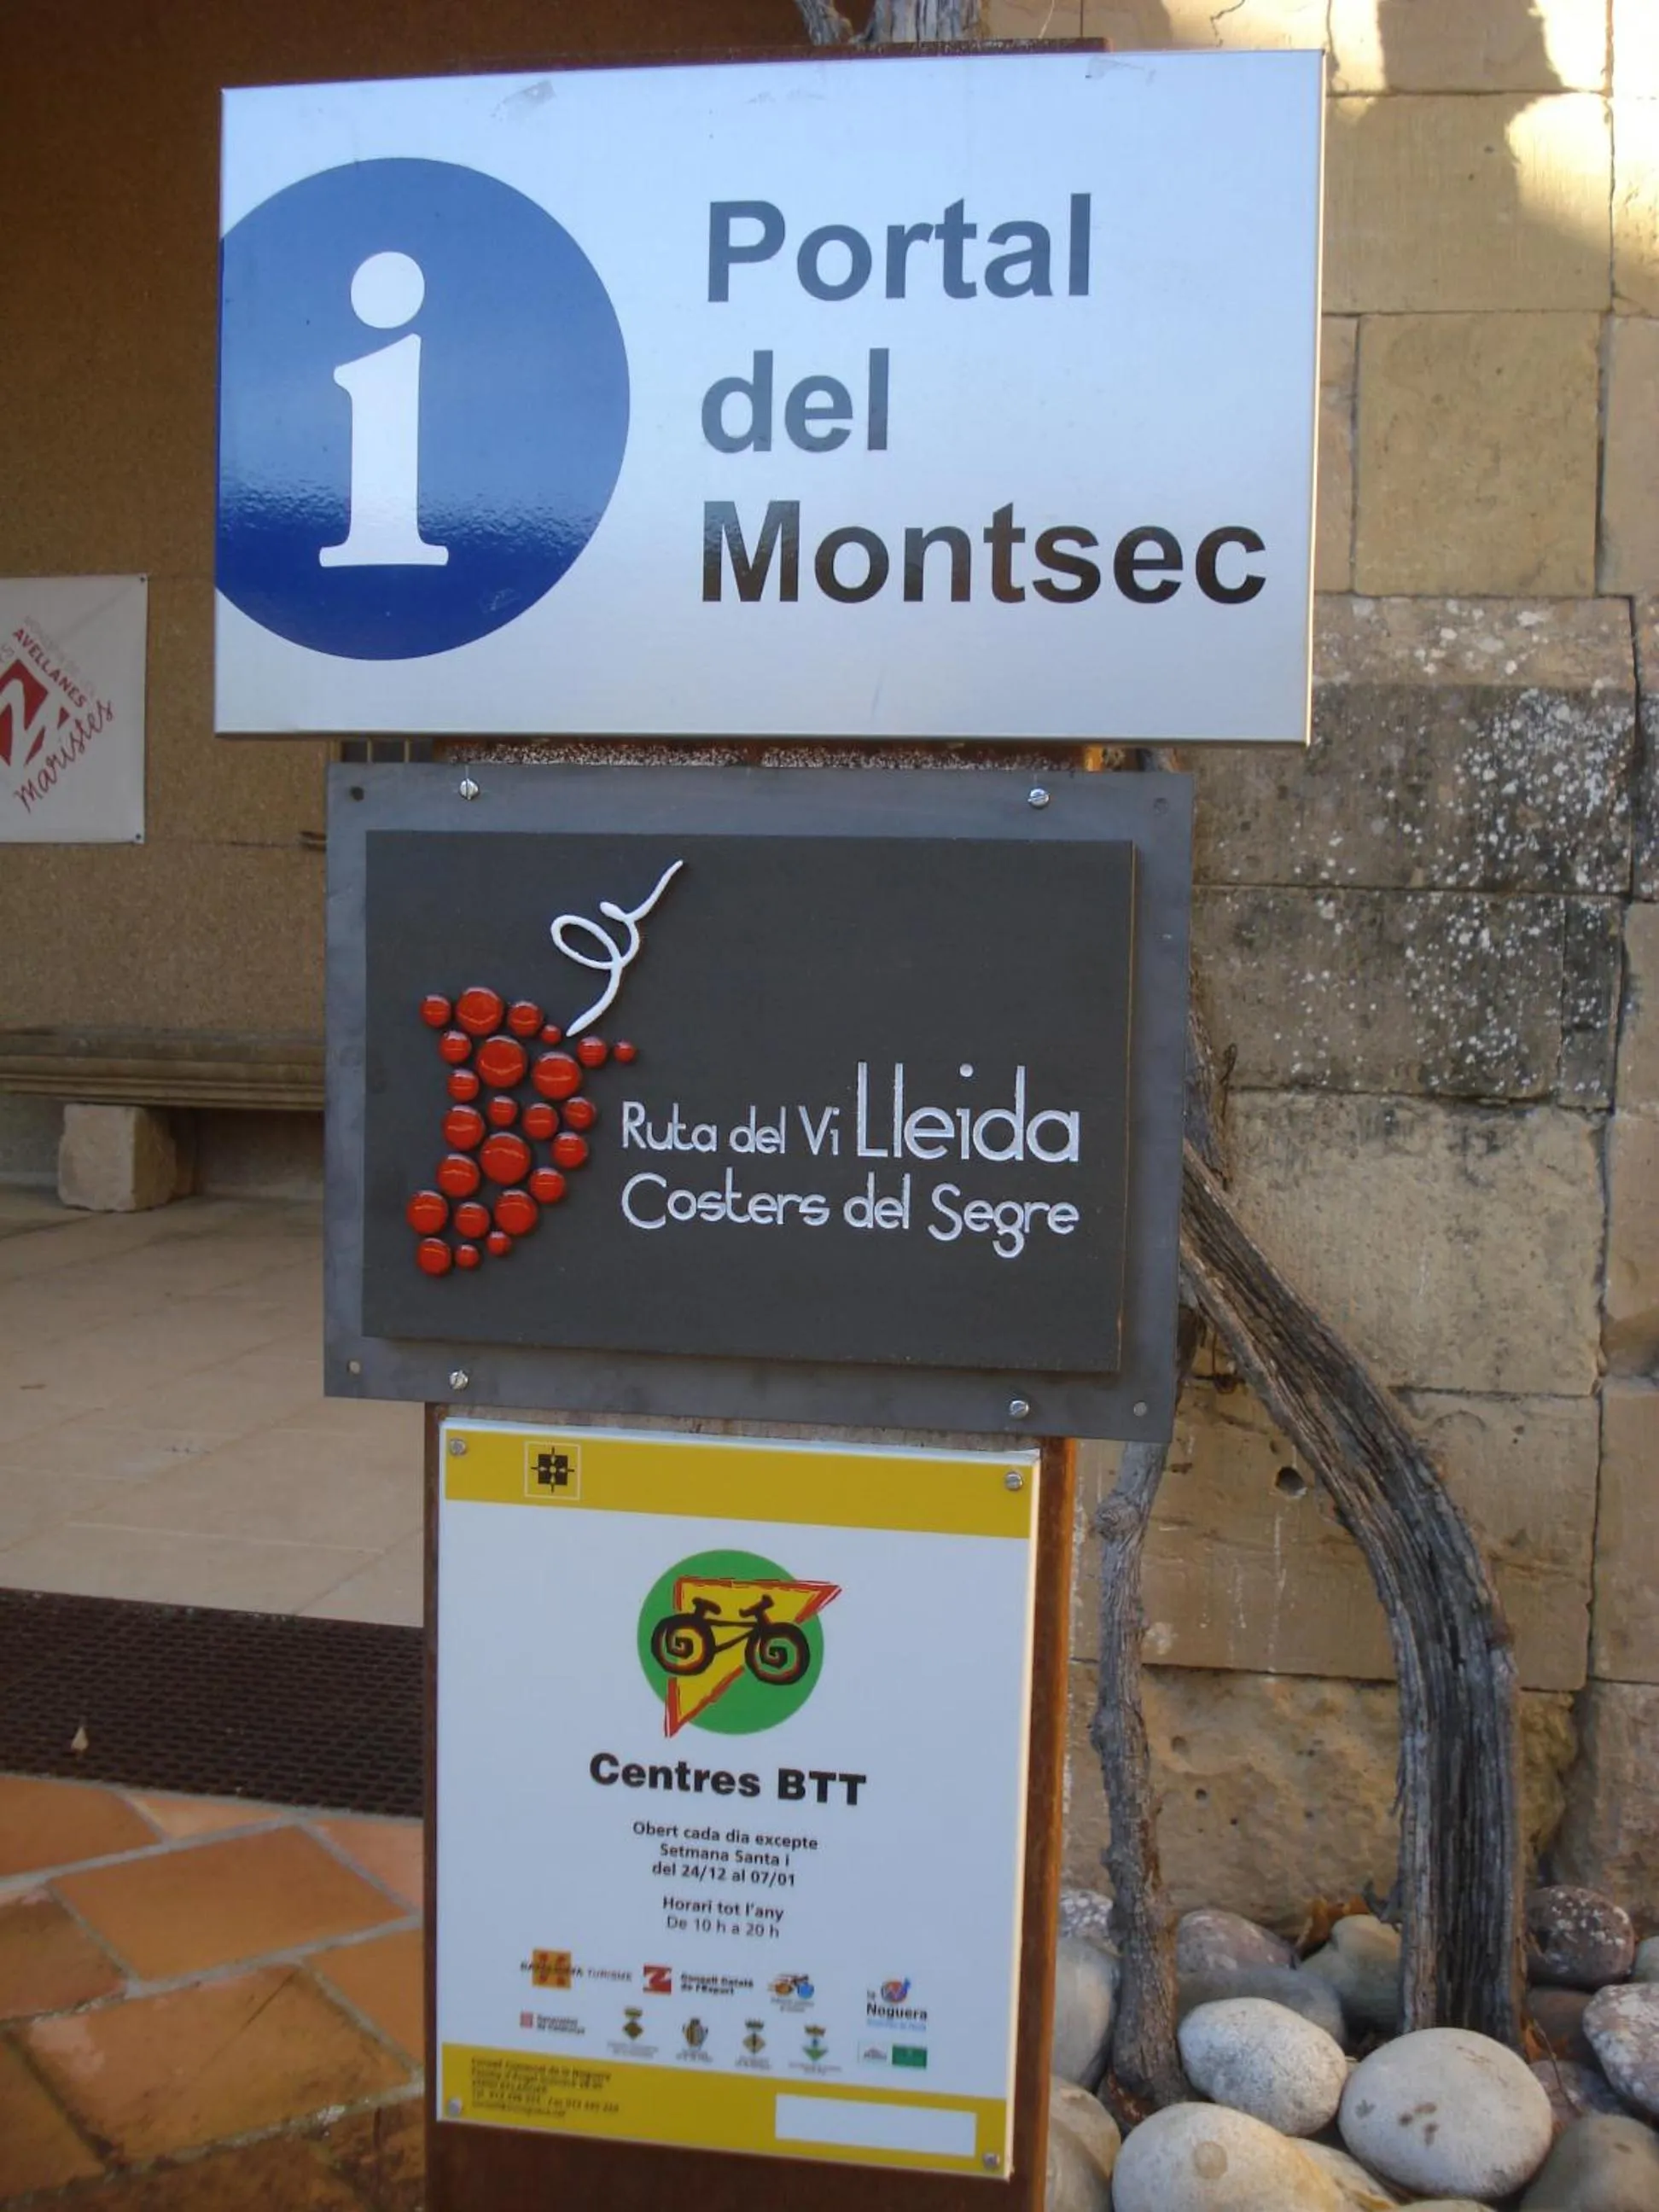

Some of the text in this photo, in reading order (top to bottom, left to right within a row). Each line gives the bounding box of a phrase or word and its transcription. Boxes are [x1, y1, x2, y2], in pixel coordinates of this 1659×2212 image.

[707, 193, 1091, 303] Portal
[701, 347, 889, 453] del
[701, 499, 1267, 606] Montsec
[12, 627, 88, 708] AVELLANES
[621, 1061, 1080, 1163] Ruta del Vi Lleida
[620, 1167, 1080, 1259] Costers del Segre
[589, 1752, 867, 1806] Centres BTT
[632, 1820, 678, 1838] Obert
[683, 1826, 720, 1842] cada
[754, 1834, 818, 1850] excepte
[660, 1843, 790, 1867] Setmana Santa i
[652, 1861, 795, 1888] del 24/12 al 07/01
[662, 1895, 784, 1922] Horari tot l'any
[667, 1915, 780, 1939] De 10 h a 20 h
[866, 2003, 928, 2020] Noguera
